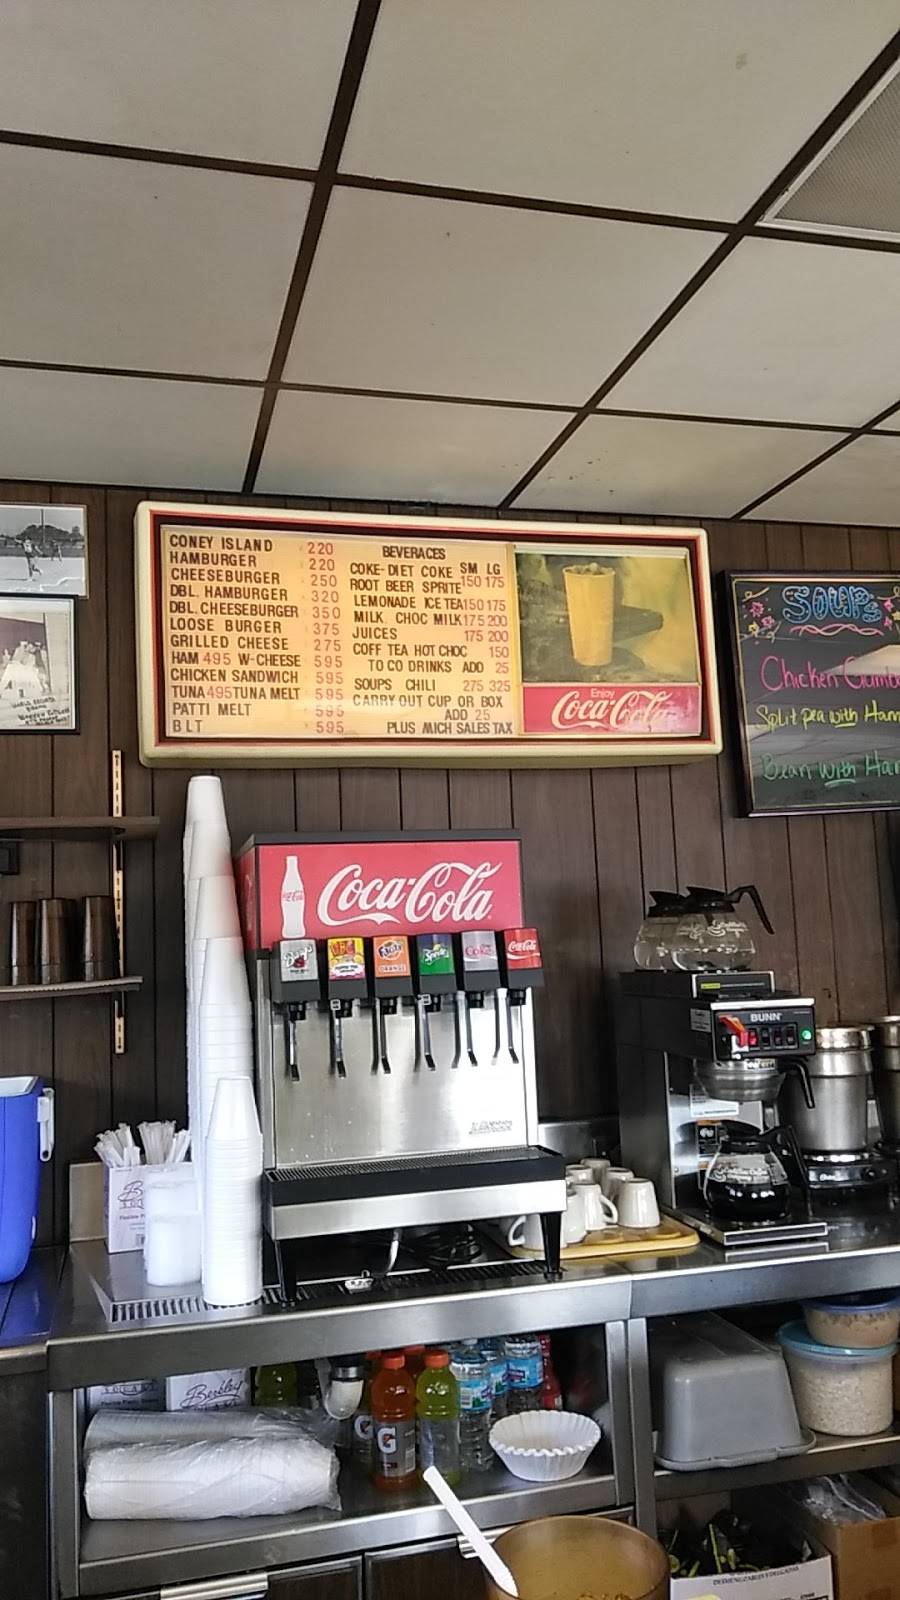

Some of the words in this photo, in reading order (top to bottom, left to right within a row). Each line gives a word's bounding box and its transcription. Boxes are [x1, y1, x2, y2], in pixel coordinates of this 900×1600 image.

[170, 535, 213, 549] CONEY
[222, 538, 272, 552] ISLAND
[308, 542, 333, 555] 220
[170, 552, 256, 567] HAMBURGER
[309, 559, 335, 571] 220
[460, 562, 477, 574] SM
[487, 564, 500, 575] LG
[171, 568, 280, 584] CHEESEBURGER
[311, 574, 337, 587] 250
[421, 566, 453, 578] COKE
[350, 579, 379, 591] ROOT
[386, 580, 414, 592] BEER
[422, 582, 461, 594] SPRITE
[461, 575, 481, 587] 150
[485, 576, 504, 588] 175
[205, 585, 287, 601] HAMBURGER
[312, 591, 339, 603] 320
[200, 602, 298, 618] CHEESEBURGER
[313, 607, 340, 619] 350
[354, 595, 416, 608] LEMONADE
[425, 598, 441, 609] ICE
[445, 598, 463, 610] TEA
[464, 599, 484, 610] 150
[487, 600, 506, 611] 175
[170, 618, 214, 631] LOOSE
[225, 620, 281, 633] BURGER
[314, 623, 339, 635] 375
[354, 611, 383, 623] MILK
[396, 612, 427, 625] CHOC
[434, 614, 463, 625] MILK
[463, 614, 485, 626] 175
[488, 615, 507, 626] 200
[352, 627, 397, 639] JUICES
[464, 630, 483, 642] 175
[488, 631, 508, 642] 200
[170, 635, 228, 648] GRILLED
[238, 637, 288, 650] CHEESE
[314, 639, 341, 652] 275
[353, 643, 382, 655] COFF
[388, 644, 408, 656] TEA
[414, 645, 435, 657] HOT
[439, 645, 467, 657] CHOC
[489, 646, 509, 658] 150
[172, 652, 198, 665] HAM
[203, 653, 231, 665] 495
[238, 654, 300, 667] W-CHEESE
[314, 656, 342, 668] 595
[368, 659, 383, 671] TO
[409, 661, 452, 673] DRINKS
[463, 661, 484, 673] ADD
[496, 662, 509, 673] 25
[171, 668, 226, 682] CHICKEN
[232, 670, 298, 683] SANDWICH
[316, 672, 343, 684] 595
[761, 656, 838, 691] Chicken
[172, 686, 205, 698] TUNA
[207, 687, 232, 699] 495
[233, 687, 266, 699] TUNA
[270, 687, 300, 700] MELT
[315, 688, 343, 700] 595
[354, 678, 392, 691] SOUPS
[406, 679, 436, 691] CHILI
[463, 680, 483, 691] 275
[489, 680, 510, 692] 325
[353, 694, 395, 706] CARRY
[399, 695, 423, 707] OUT
[428, 696, 451, 707] CUP
[458, 696, 474, 707] OR
[481, 696, 503, 707] BOX
[590, 688, 615, 699] Enjoy
[173, 703, 209, 715] PATTI
[218, 704, 251, 716] MELT
[316, 705, 344, 717] 595
[445, 709, 467, 720] ADD
[475, 709, 490, 720] 25
[756, 704, 797, 732] Split
[829, 707, 858, 724] with
[316, 721, 344, 734] 595
[387, 722, 415, 734] PLUS
[422, 722, 452, 734] MICH
[456, 723, 490, 734] SALES
[492, 722, 513, 734] TAX
[761, 753, 811, 780] Bean
[819, 754, 856, 779] with
[317, 861, 502, 926] Coca-Cola
[750, 1013, 782, 1022] BUNN
[377, 1427, 396, 1454] G
